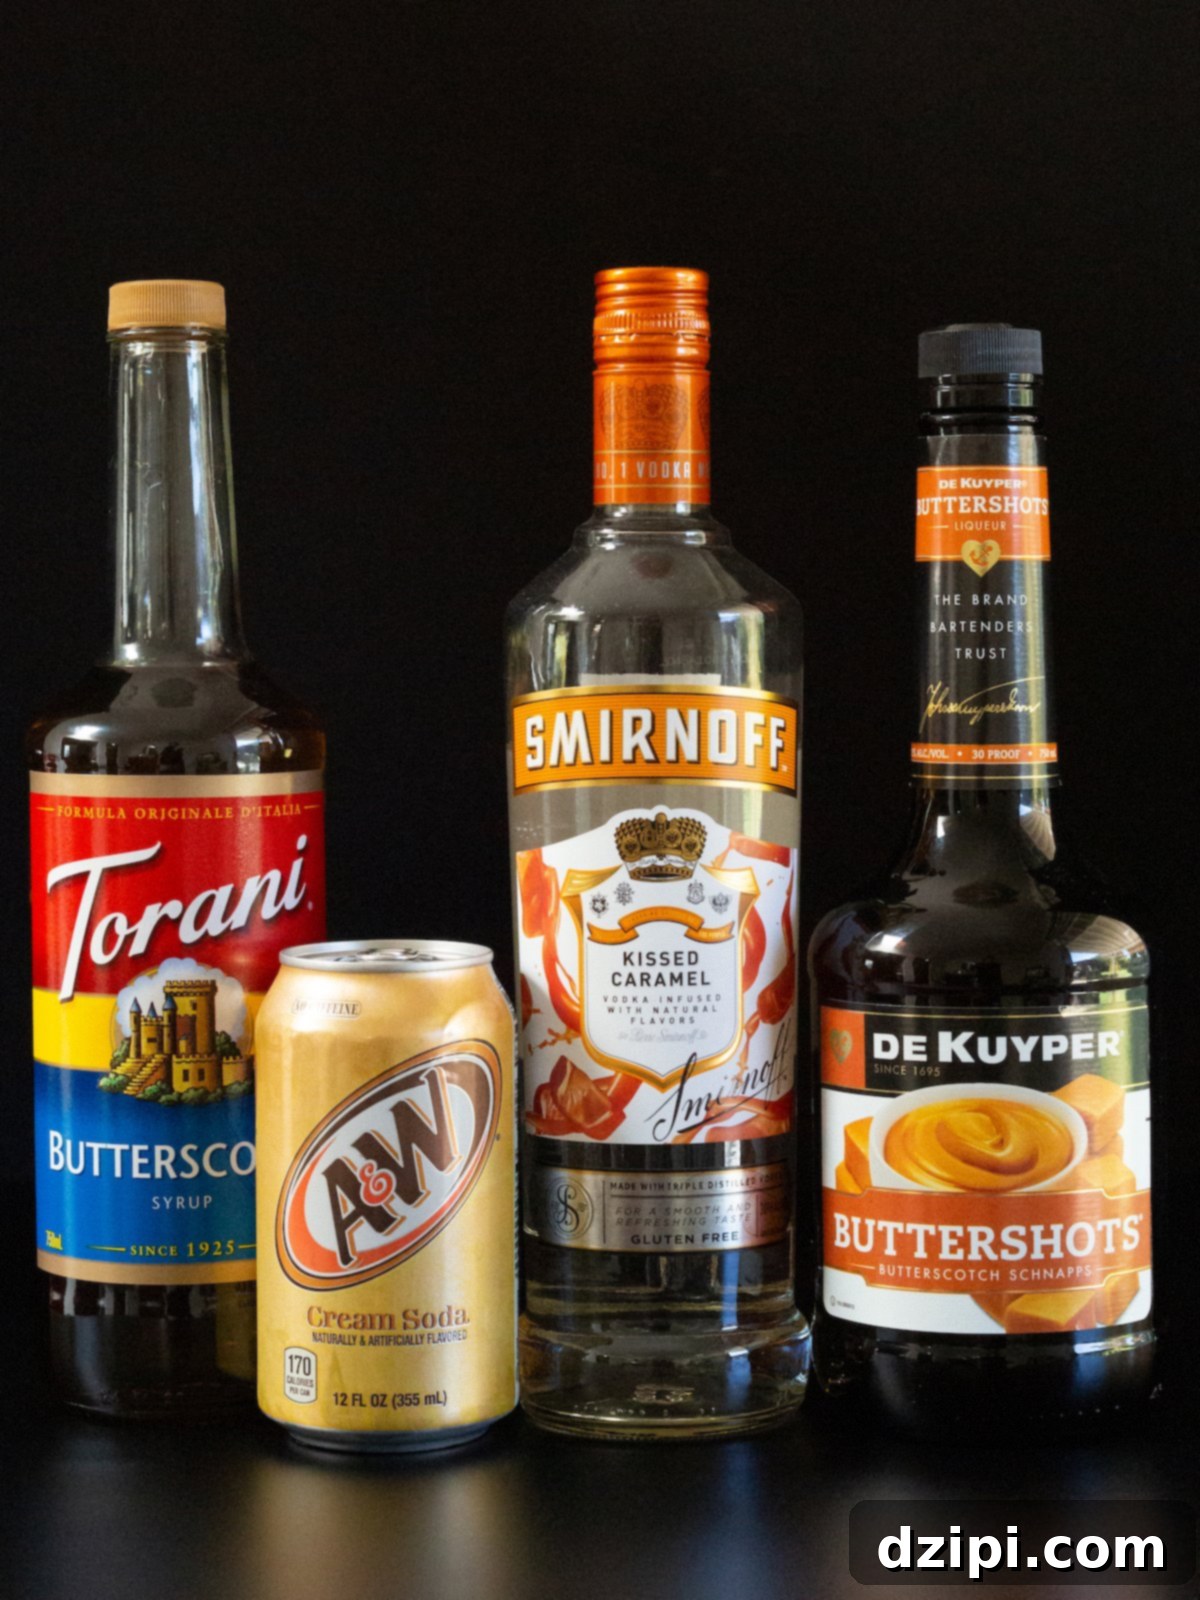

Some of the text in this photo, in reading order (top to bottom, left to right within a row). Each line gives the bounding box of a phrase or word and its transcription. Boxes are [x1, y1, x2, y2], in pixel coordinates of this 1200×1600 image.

[636, 460, 691, 480] VODKA
[938, 477, 1022, 489] DE KUYPER
[916, 495, 1049, 516] BUTTERSHOTS
[954, 520, 1007, 531] LIQUEUR
[934, 594, 1028, 606] THE BRAND
[929, 620, 1034, 633] BARTENDERS
[955, 647, 1007, 660] TRUST
[525, 707, 786, 771] SMIRNOFF
[971, 749, 1021, 759] 30 PROOF
[57, 804, 127, 820] FORMULA
[240, 803, 302, 818] D'ITALIA
[46, 833, 309, 1004] Torani
[622, 951, 699, 967] KISSED
[611, 971, 711, 987] CARAMEL
[603, 994, 722, 1004] VODKA INFUSED
[607, 1005, 717, 1014] WITH NATURAL
[630, 1017, 696, 1025] FLAVORS
[873, 1031, 1121, 1064] DE KUYPER
[874, 1063, 941, 1077] SINCE 1695
[644, 1017, 791, 1142] Sminoff
[49, 1129, 256, 1179] BUTTERSCO
[320, 1066, 463, 1270] A&W
[610, 1182, 636, 1191] MADE
[151, 1195, 213, 1210] SYRUP
[631, 1231, 739, 1245] GLUTEN FREE
[833, 1212, 1140, 1261] BUTTERSHOTS
[130, 1241, 235, 1257] SINCE 1925
[878, 1263, 1092, 1281] BUTTERSCOTCH SCHNAPPS
[306, 1304, 470, 1331] Cream Soda
[312, 1329, 467, 1346] NATURALLY & ARTIFICIALLY FLAVORED
[288, 1354, 311, 1376] 170
[333, 1390, 448, 1410] 12 FL OZ (355 mL)
